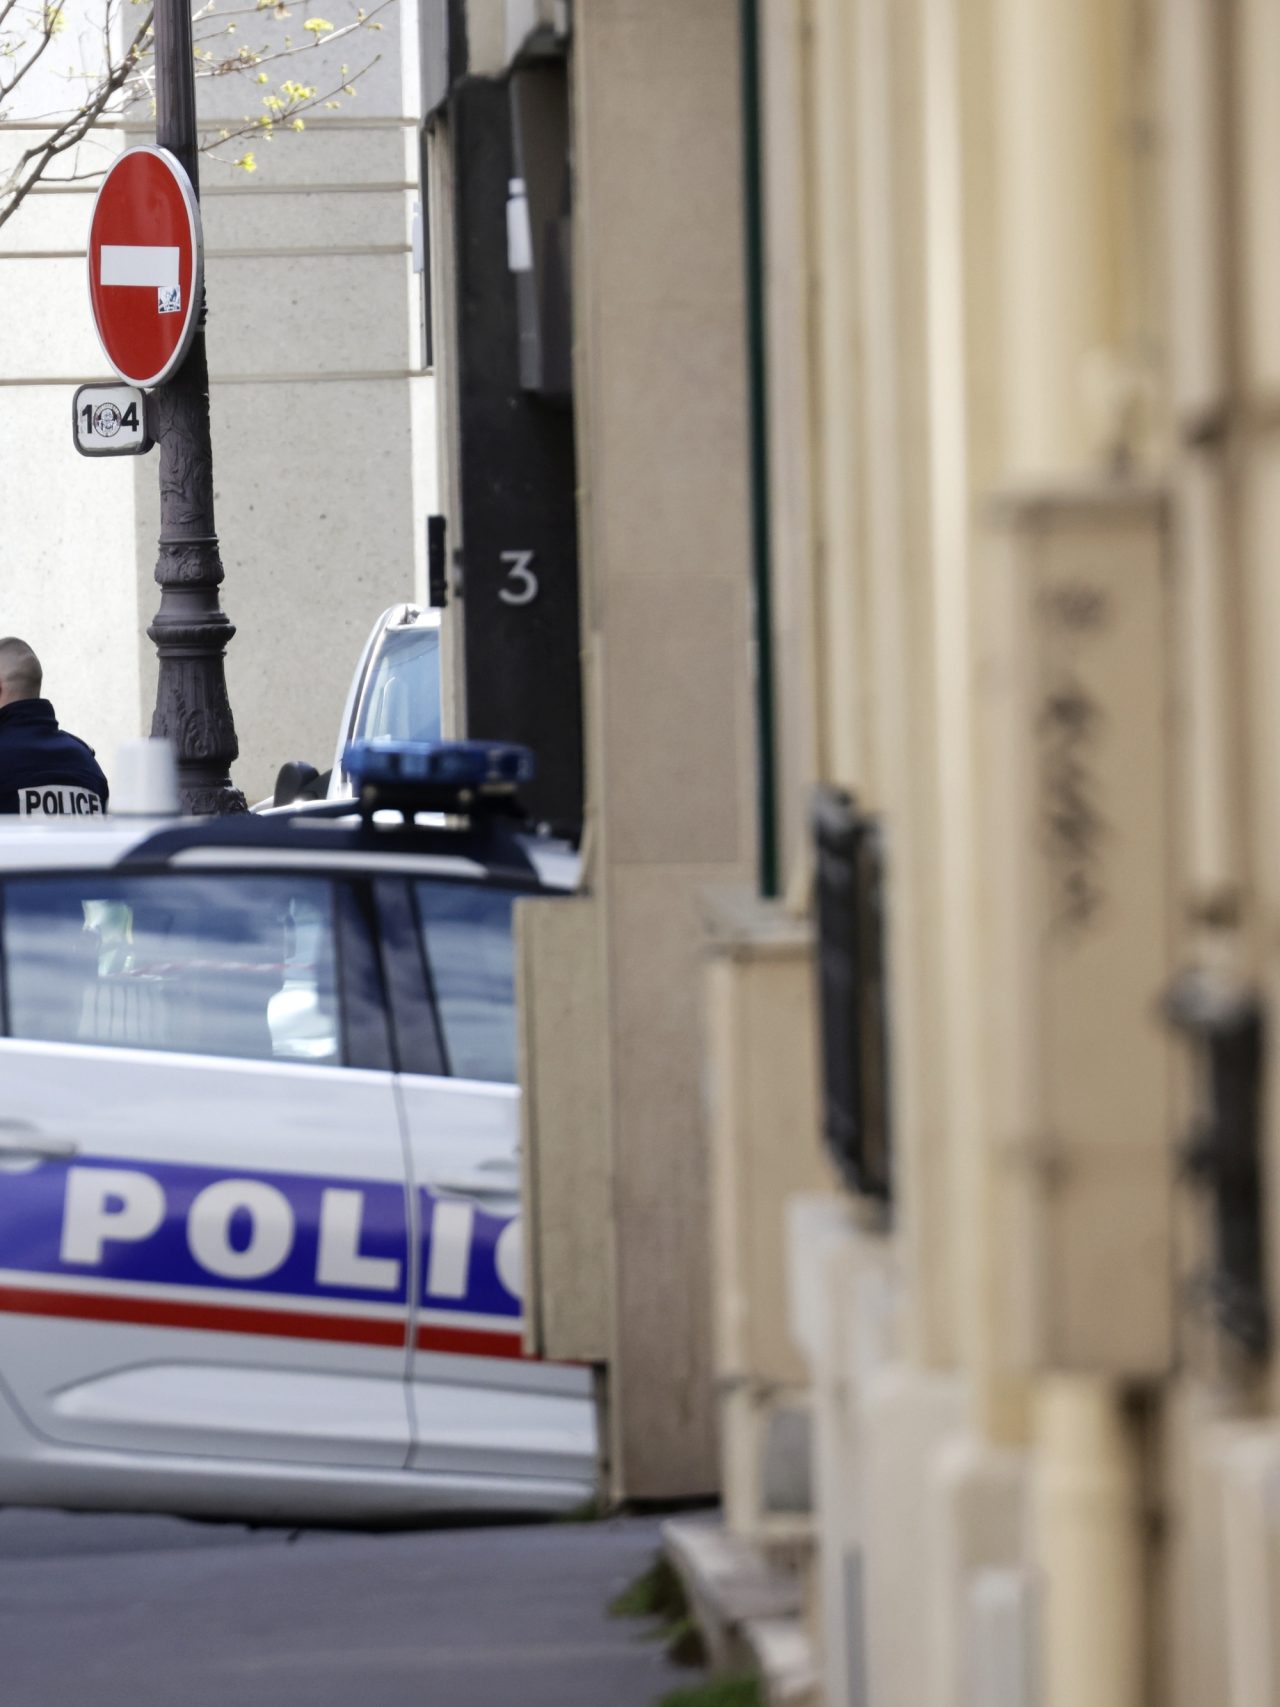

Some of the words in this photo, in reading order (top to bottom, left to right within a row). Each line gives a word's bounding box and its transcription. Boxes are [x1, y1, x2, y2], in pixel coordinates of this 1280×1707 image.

[82, 402, 139, 434] 14
[497, 551, 539, 605] 3
[25, 790, 99, 815] POLICE
